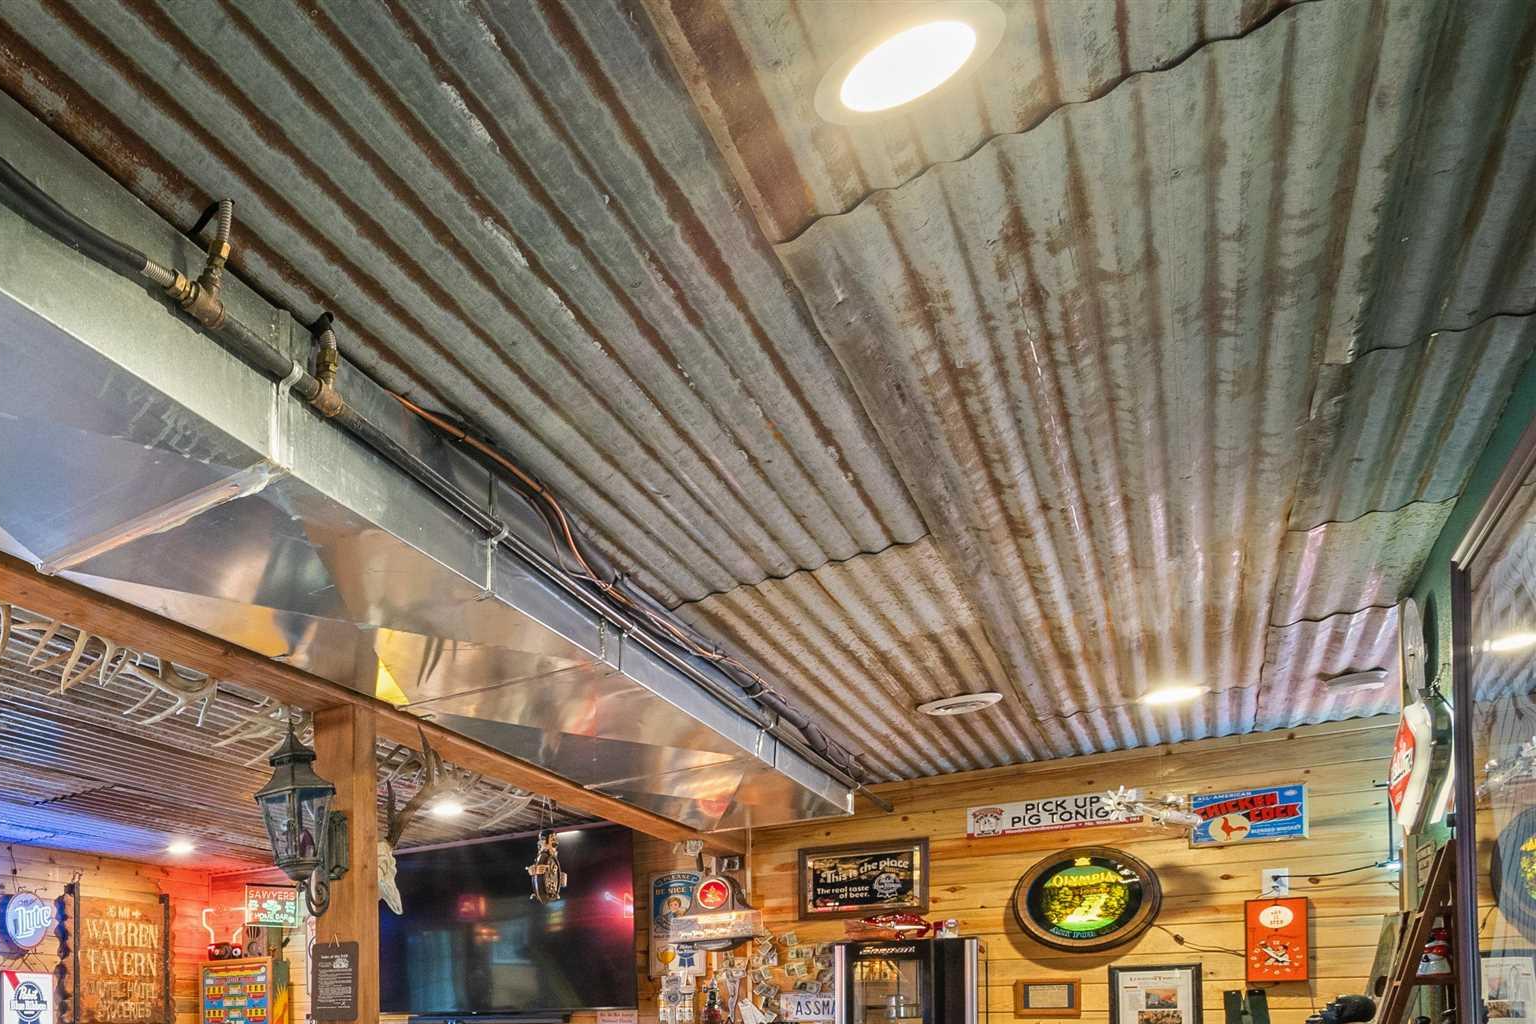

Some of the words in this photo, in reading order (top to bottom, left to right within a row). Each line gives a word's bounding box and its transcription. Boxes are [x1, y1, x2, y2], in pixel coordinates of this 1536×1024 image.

[1025, 800, 1067, 815] PICK
[1075, 796, 1101, 809] UP
[1194, 792, 1278, 821] CHICKEN
[1249, 804, 1298, 823] COCK
[1011, 814, 1041, 828] PIG
[1049, 807, 1115, 824] TONIG
[821, 869, 847, 883] This
[849, 869, 858, 879] is
[859, 861, 878, 874] the
[879, 858, 910, 871] place
[1053, 871, 1116, 888] OLYMPIA
[248, 889, 296, 901] SAWYERS
[832, 886, 848, 894] real
[849, 885, 870, 893] taste
[13, 904, 53, 940] Lite
[86, 918, 159, 949] WARREN
[87, 948, 158, 977] TAVERN
[18, 985, 39, 1000] Pabst
